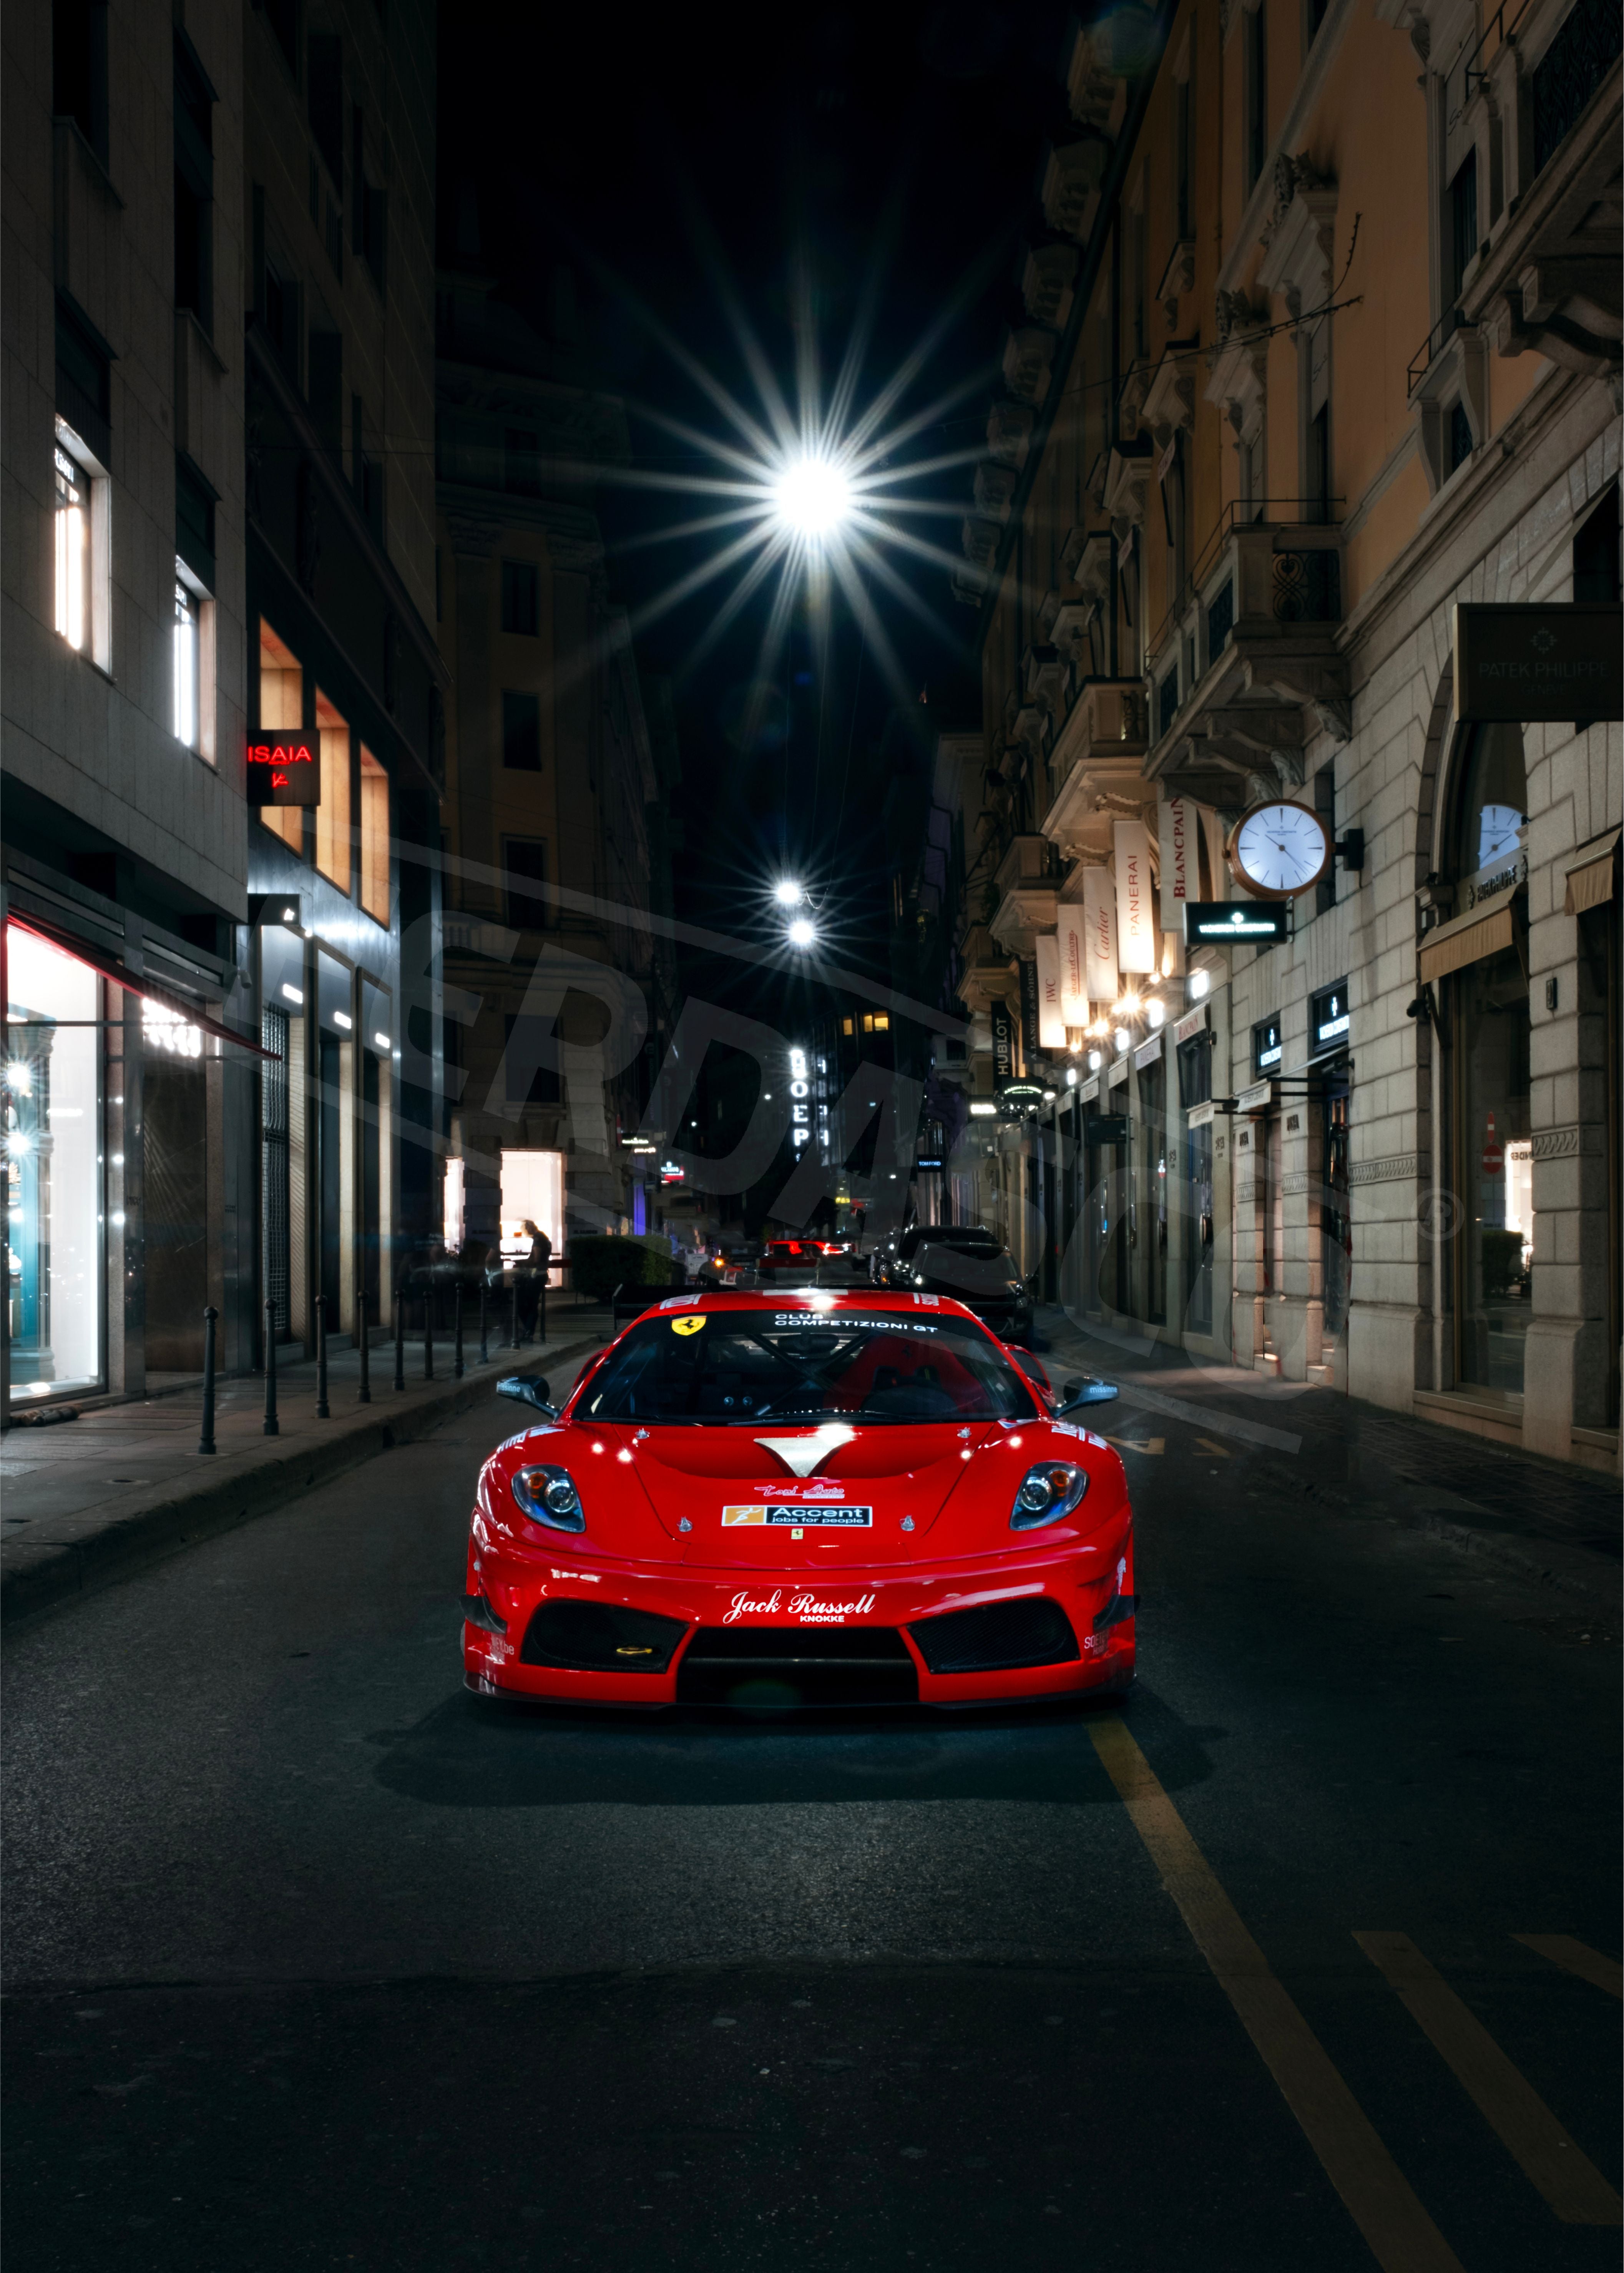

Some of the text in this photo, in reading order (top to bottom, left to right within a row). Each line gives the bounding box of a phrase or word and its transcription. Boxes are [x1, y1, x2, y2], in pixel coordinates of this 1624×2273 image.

[1478, 662, 1610, 678] PATEK PHILIPPE
[248, 746, 312, 762] ISAIA
[1171, 798, 1186, 898] BLANCPAIN
[1128, 856, 1139, 935] PANERAI
[1094, 907, 1109, 960] Cartier
[1046, 978, 1056, 1002] IWC
[996, 1018, 1008, 1075] HUBLOT
[774, 1320, 908, 1330] COMPETIZIONI
[1090, 1385, 1118, 1393] missinne
[803, 1484, 845, 1494] Auto
[773, 1507, 863, 1517] Accent
[723, 1589, 876, 1624] Jack Russell
